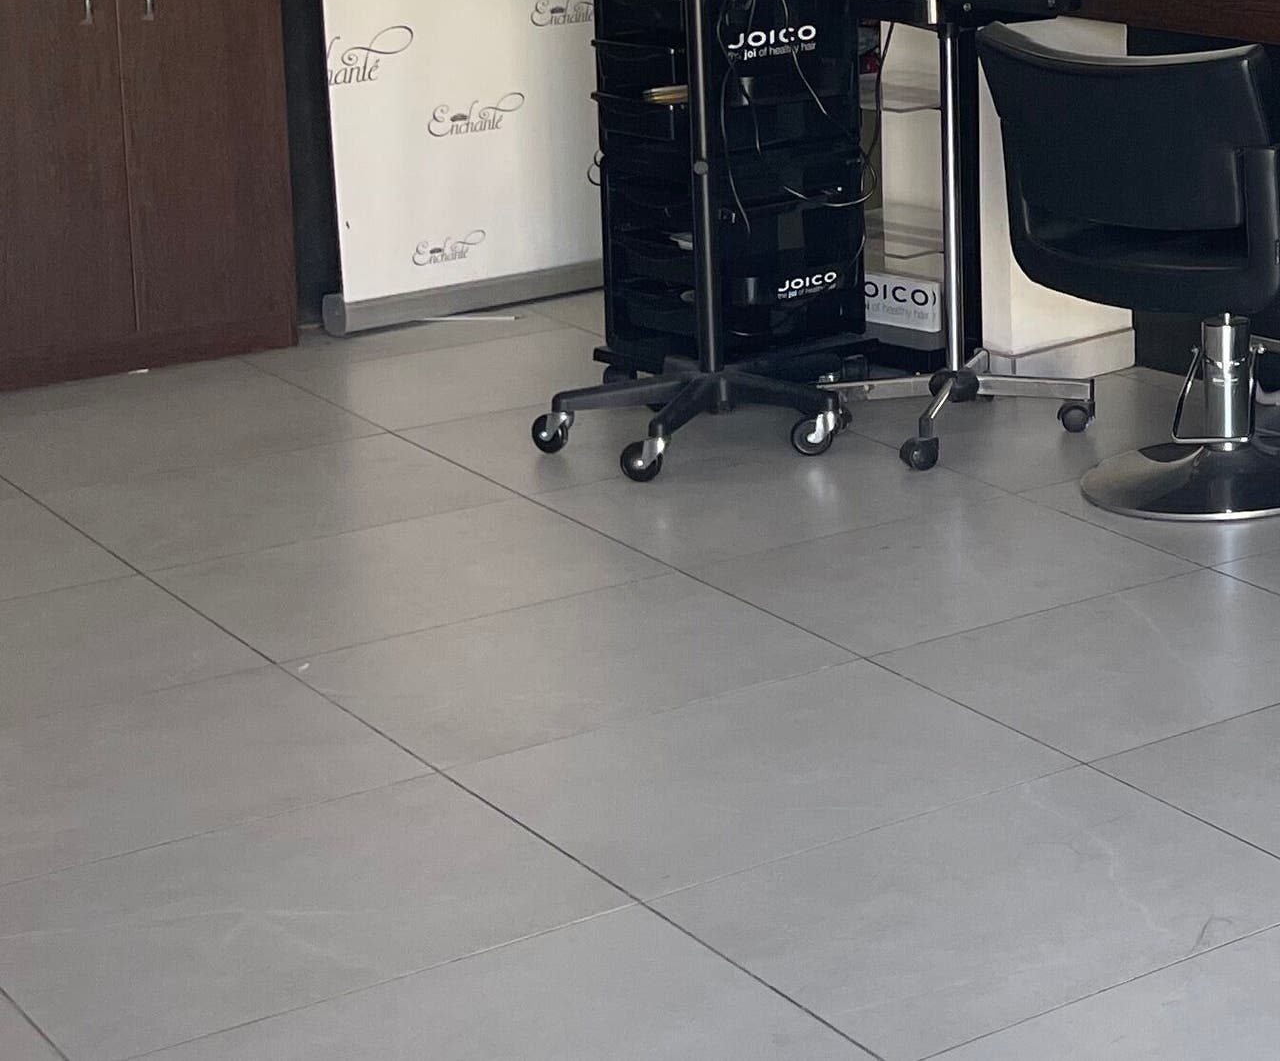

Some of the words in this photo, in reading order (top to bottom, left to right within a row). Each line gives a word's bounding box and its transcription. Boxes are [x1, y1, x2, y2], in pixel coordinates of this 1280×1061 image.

[728, 25, 817, 50] JOICO
[744, 48, 757, 61] joi
[758, 46, 768, 57] of
[427, 91, 525, 138] Enchanté
[777, 271, 837, 293] JOICO
[864, 281, 929, 307] OICO
